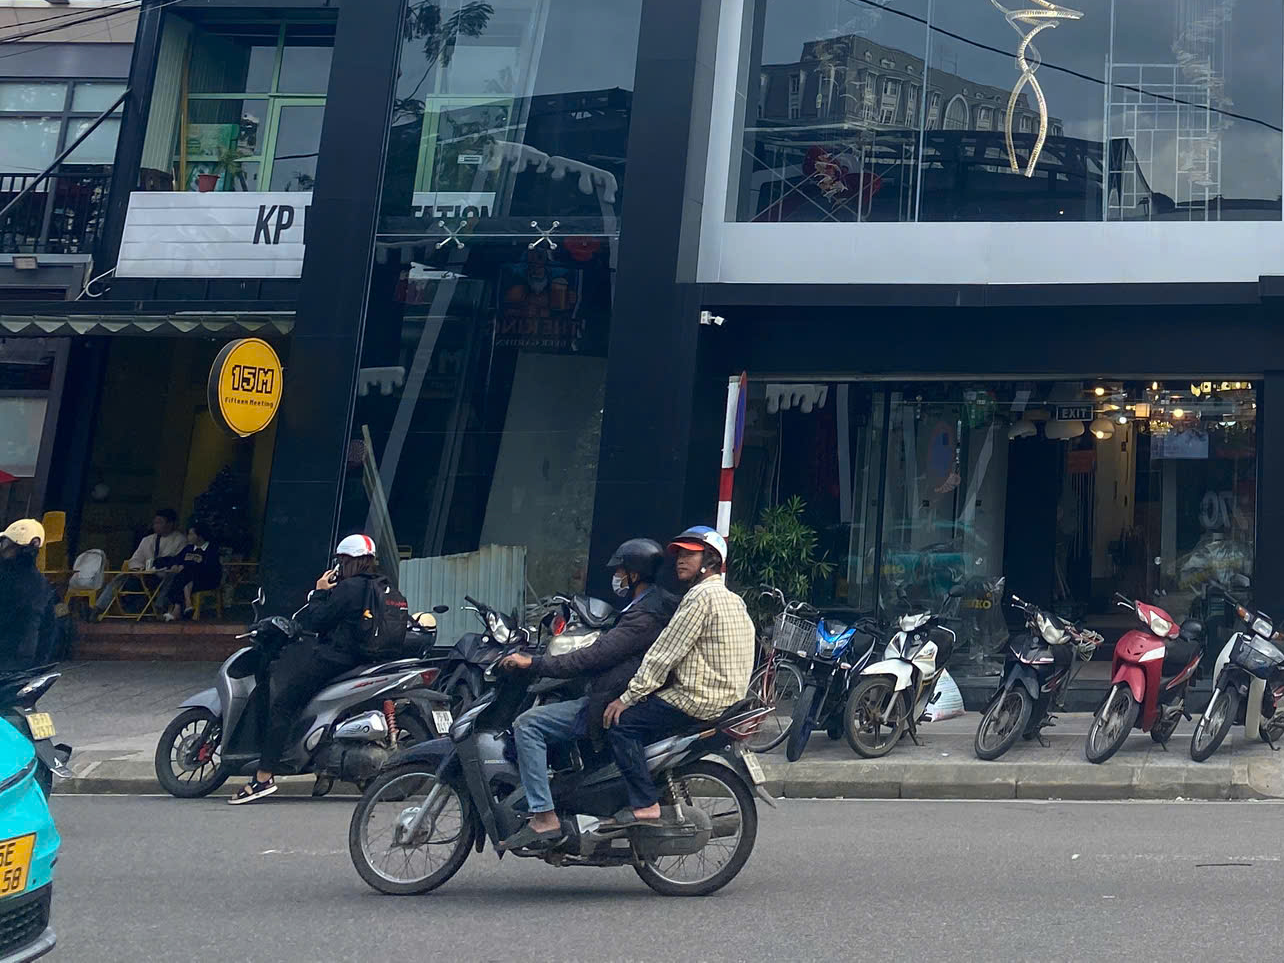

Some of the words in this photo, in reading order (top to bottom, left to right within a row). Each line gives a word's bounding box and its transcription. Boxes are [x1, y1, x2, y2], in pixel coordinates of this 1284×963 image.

[253, 205, 295, 245] KP
[231, 364, 275, 395] 15M
[1062, 408, 1088, 418] EXIT
